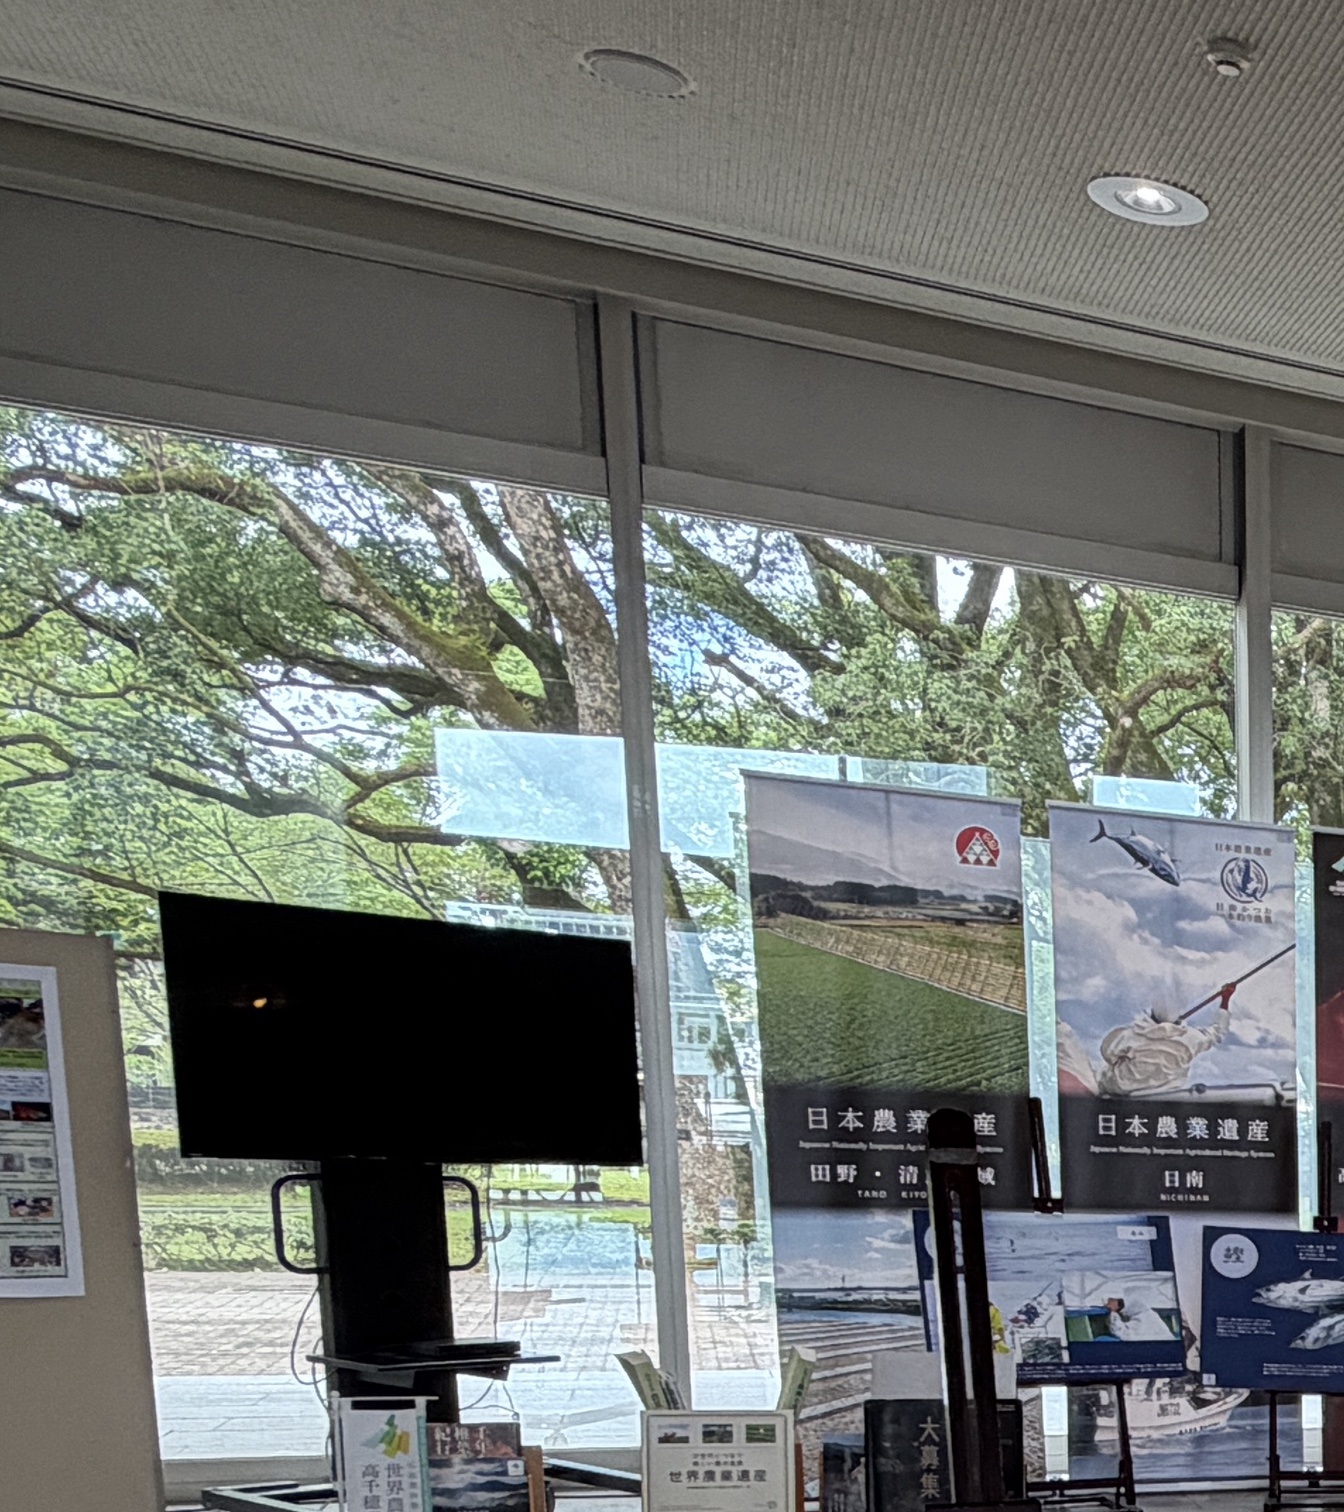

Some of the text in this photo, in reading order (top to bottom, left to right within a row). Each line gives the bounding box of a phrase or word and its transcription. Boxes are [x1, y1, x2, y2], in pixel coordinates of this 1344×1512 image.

[807, 1107, 998, 1137] 日本農業産
[1097, 1114, 1270, 1142] 日本農業遺産
[1164, 1170, 1205, 1189] 日南
[669, 1469, 767, 1483] 世界農業遺産
